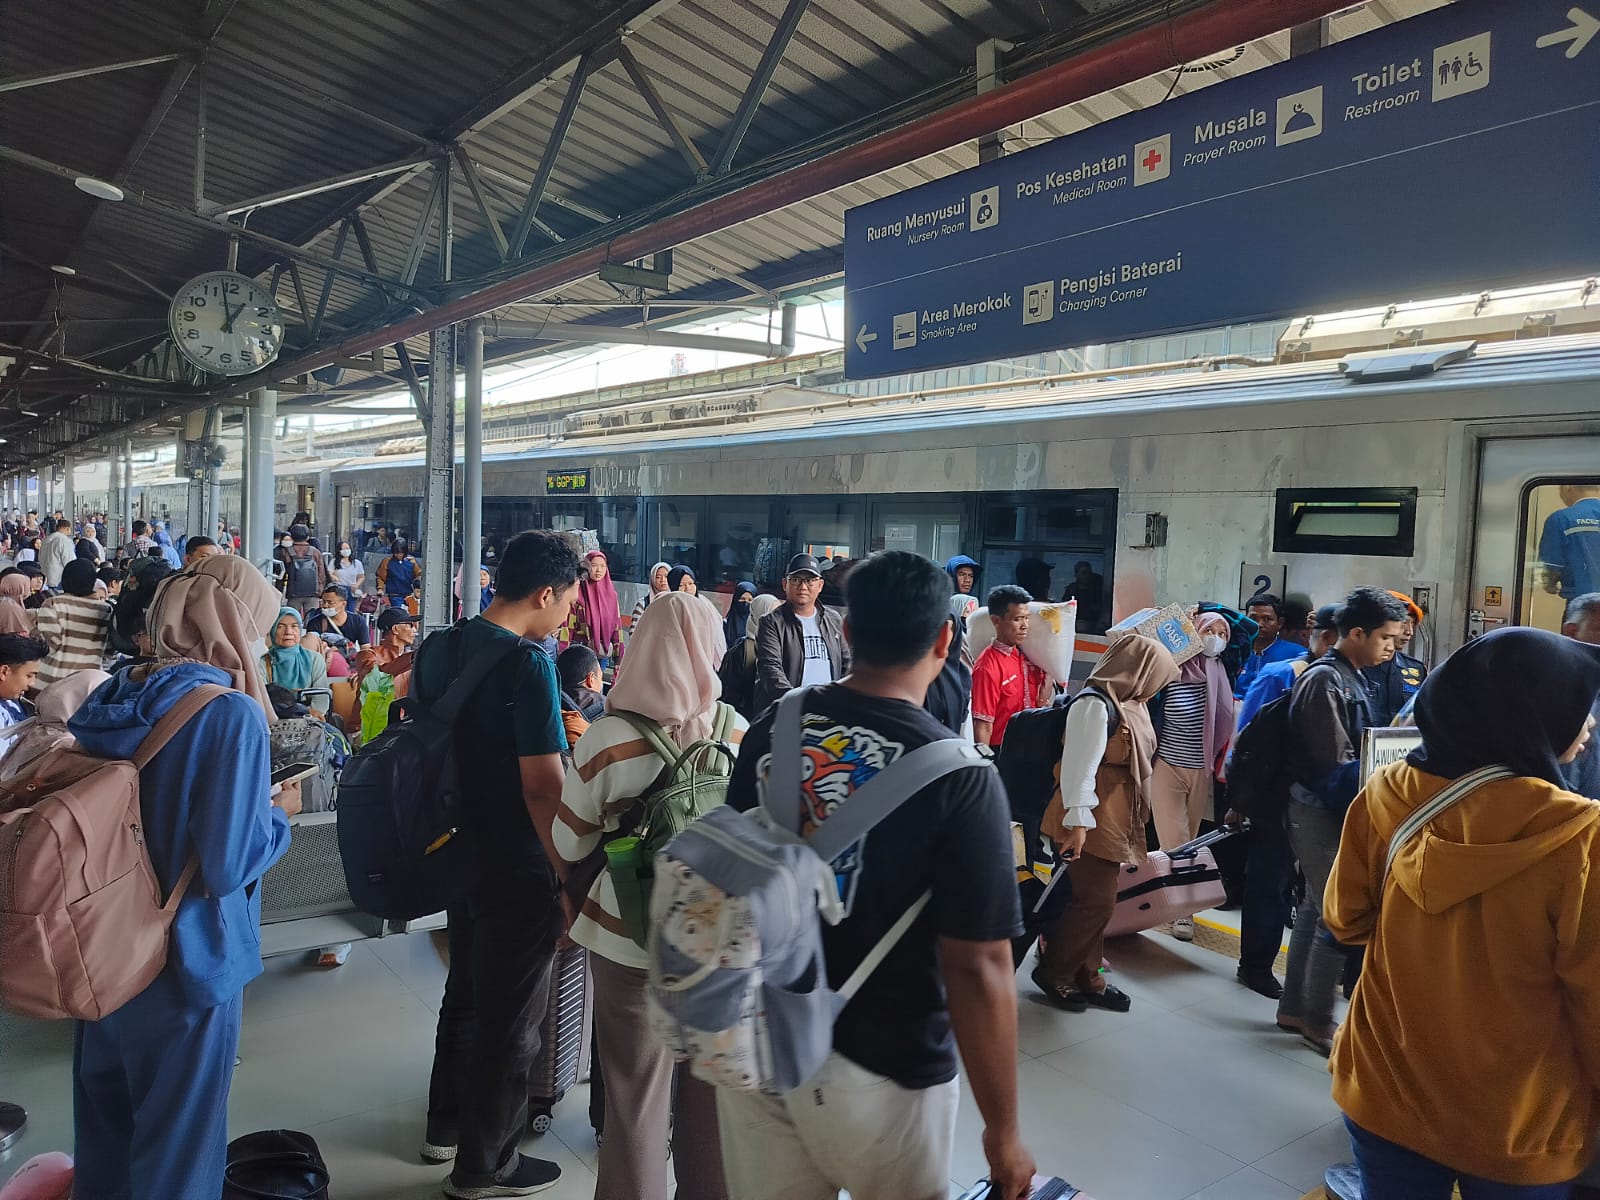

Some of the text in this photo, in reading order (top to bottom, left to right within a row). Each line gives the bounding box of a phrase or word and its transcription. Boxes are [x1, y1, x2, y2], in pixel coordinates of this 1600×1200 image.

[1351, 57, 1422, 96] Toilet
[1343, 89, 1420, 122] Restroom
[1194, 108, 1267, 145] Musala
[1183, 135, 1266, 167] Prayer Room
[1016, 154, 1127, 199] Pos Kesehatan
[1052, 176, 1127, 206] Medical Room
[867, 196, 965, 243] Ruang Menyusui
[907, 221, 965, 246] Nursery Room
[1060, 251, 1182, 296] Pengisi Baterai
[204, 285, 218, 297] 11
[225, 282, 240, 294] 12
[248, 292, 253, 301] 1
[189, 296, 206, 307] 10
[921, 292, 1012, 326] Area Merokok
[1059, 287, 1148, 313] Charging Corner
[184, 311, 196, 321] 9
[257, 307, 269, 318] 2
[187, 329, 199, 339] 8
[920, 322, 977, 341] Smoking Area
[202, 345, 214, 356] 7
[220, 353, 232, 363] 6
[241, 350, 252, 361] 5
[1253, 574, 1272, 597] 2
